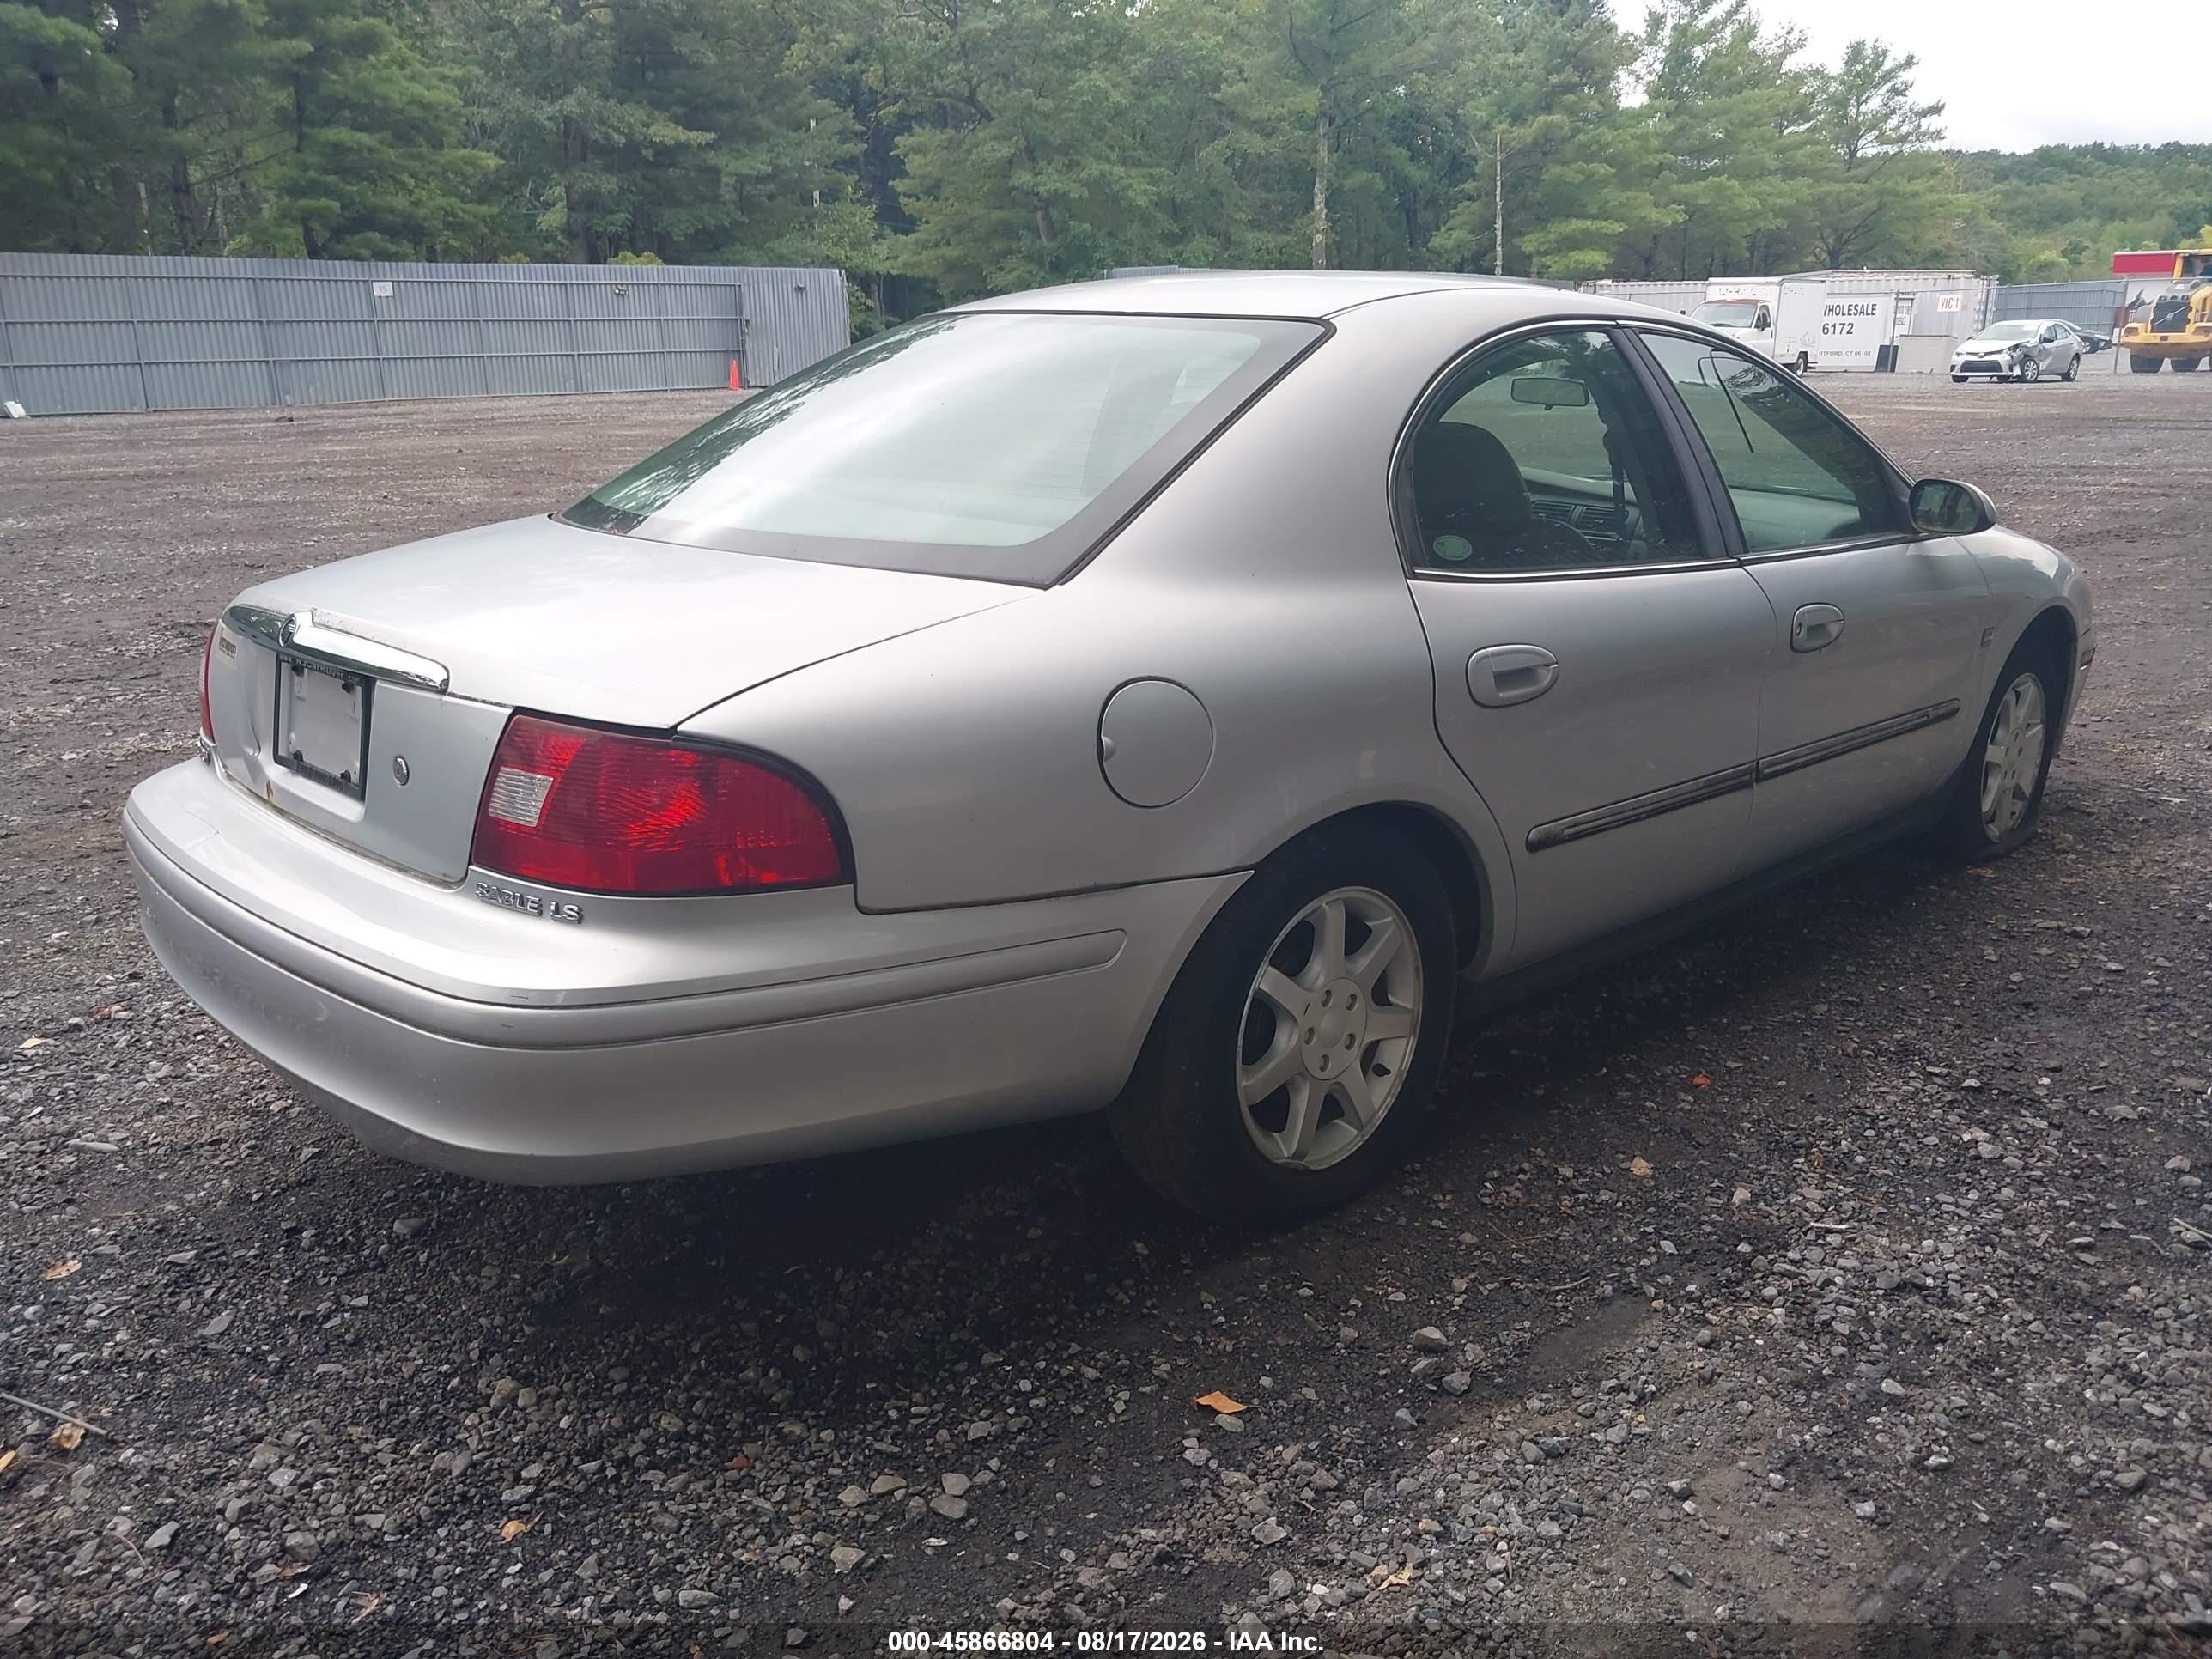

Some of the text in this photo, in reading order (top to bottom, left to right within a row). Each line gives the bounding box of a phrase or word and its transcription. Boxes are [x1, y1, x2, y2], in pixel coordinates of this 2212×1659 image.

[1823, 303, 1877, 316] HOLESALE
[1941, 297, 1960, 309] VIC 1
[1821, 322, 1854, 335] 6172
[476, 882, 584, 924] SABLE LS
